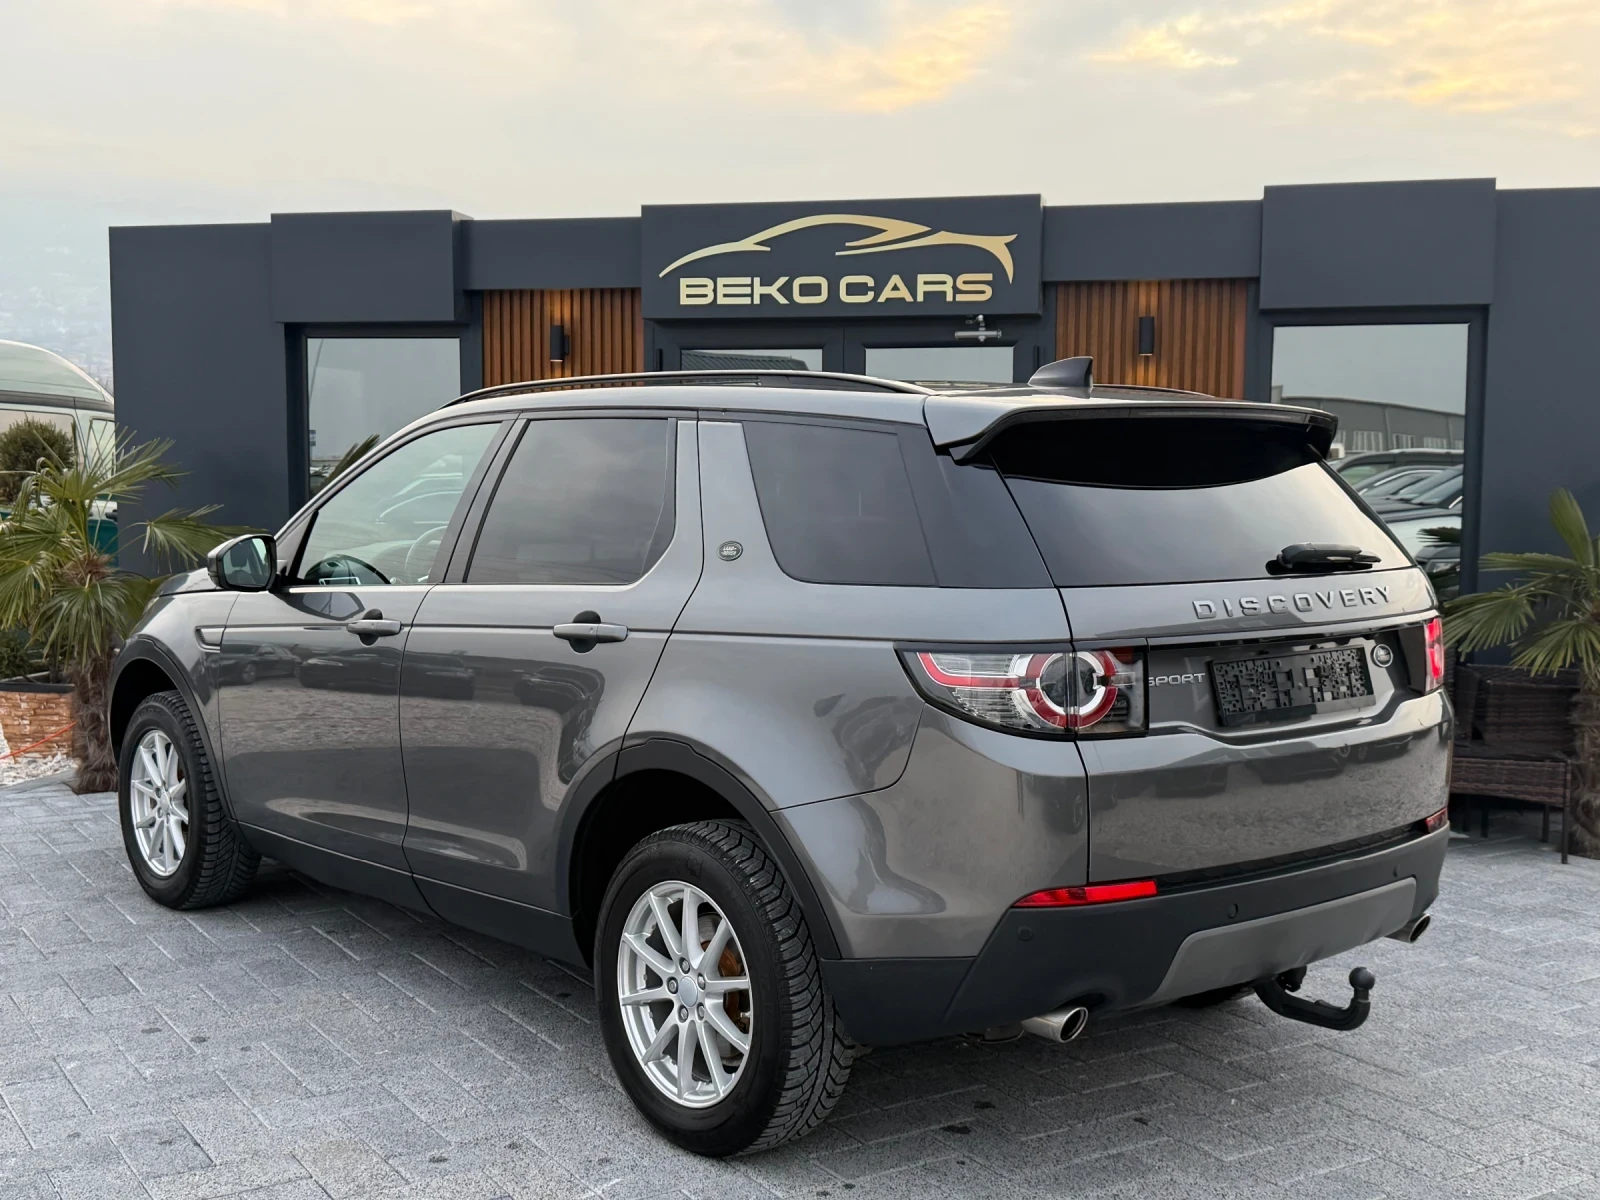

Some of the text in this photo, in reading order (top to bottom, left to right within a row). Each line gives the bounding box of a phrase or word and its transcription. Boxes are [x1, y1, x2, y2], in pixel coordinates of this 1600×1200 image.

[679, 273, 993, 305] BEKO CARS
[1192, 585, 1391, 619] DISCOVERY
